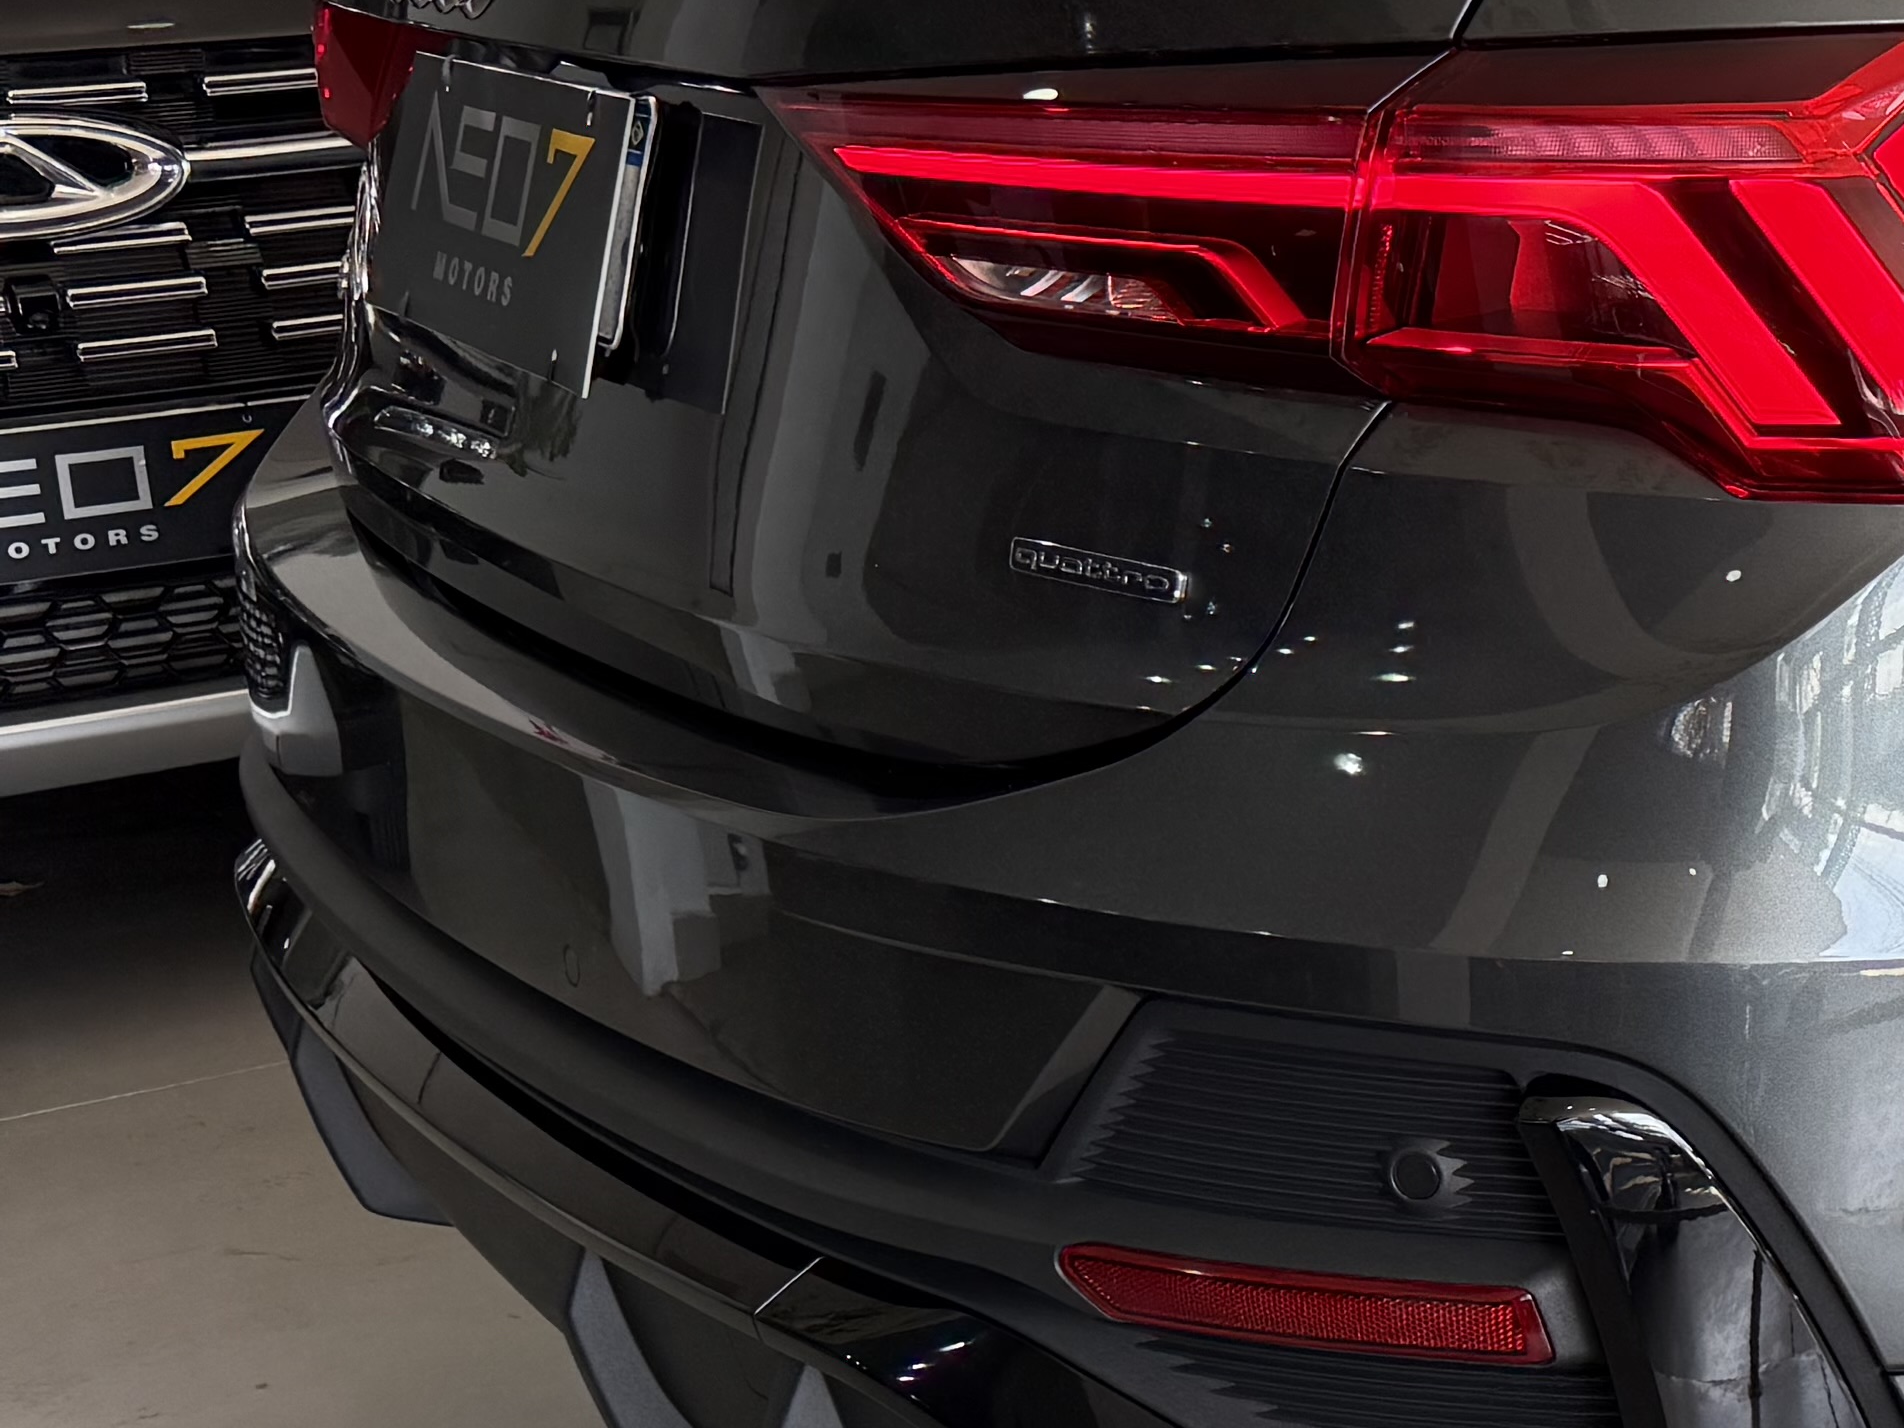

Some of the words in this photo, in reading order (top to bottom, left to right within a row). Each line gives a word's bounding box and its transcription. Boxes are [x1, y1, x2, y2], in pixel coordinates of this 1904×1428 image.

[433, 251, 513, 306] MOTORS
[0, 428, 265, 529] EO7
[7, 524, 159, 560] OTORS
[1014, 547, 1169, 592] quattro
